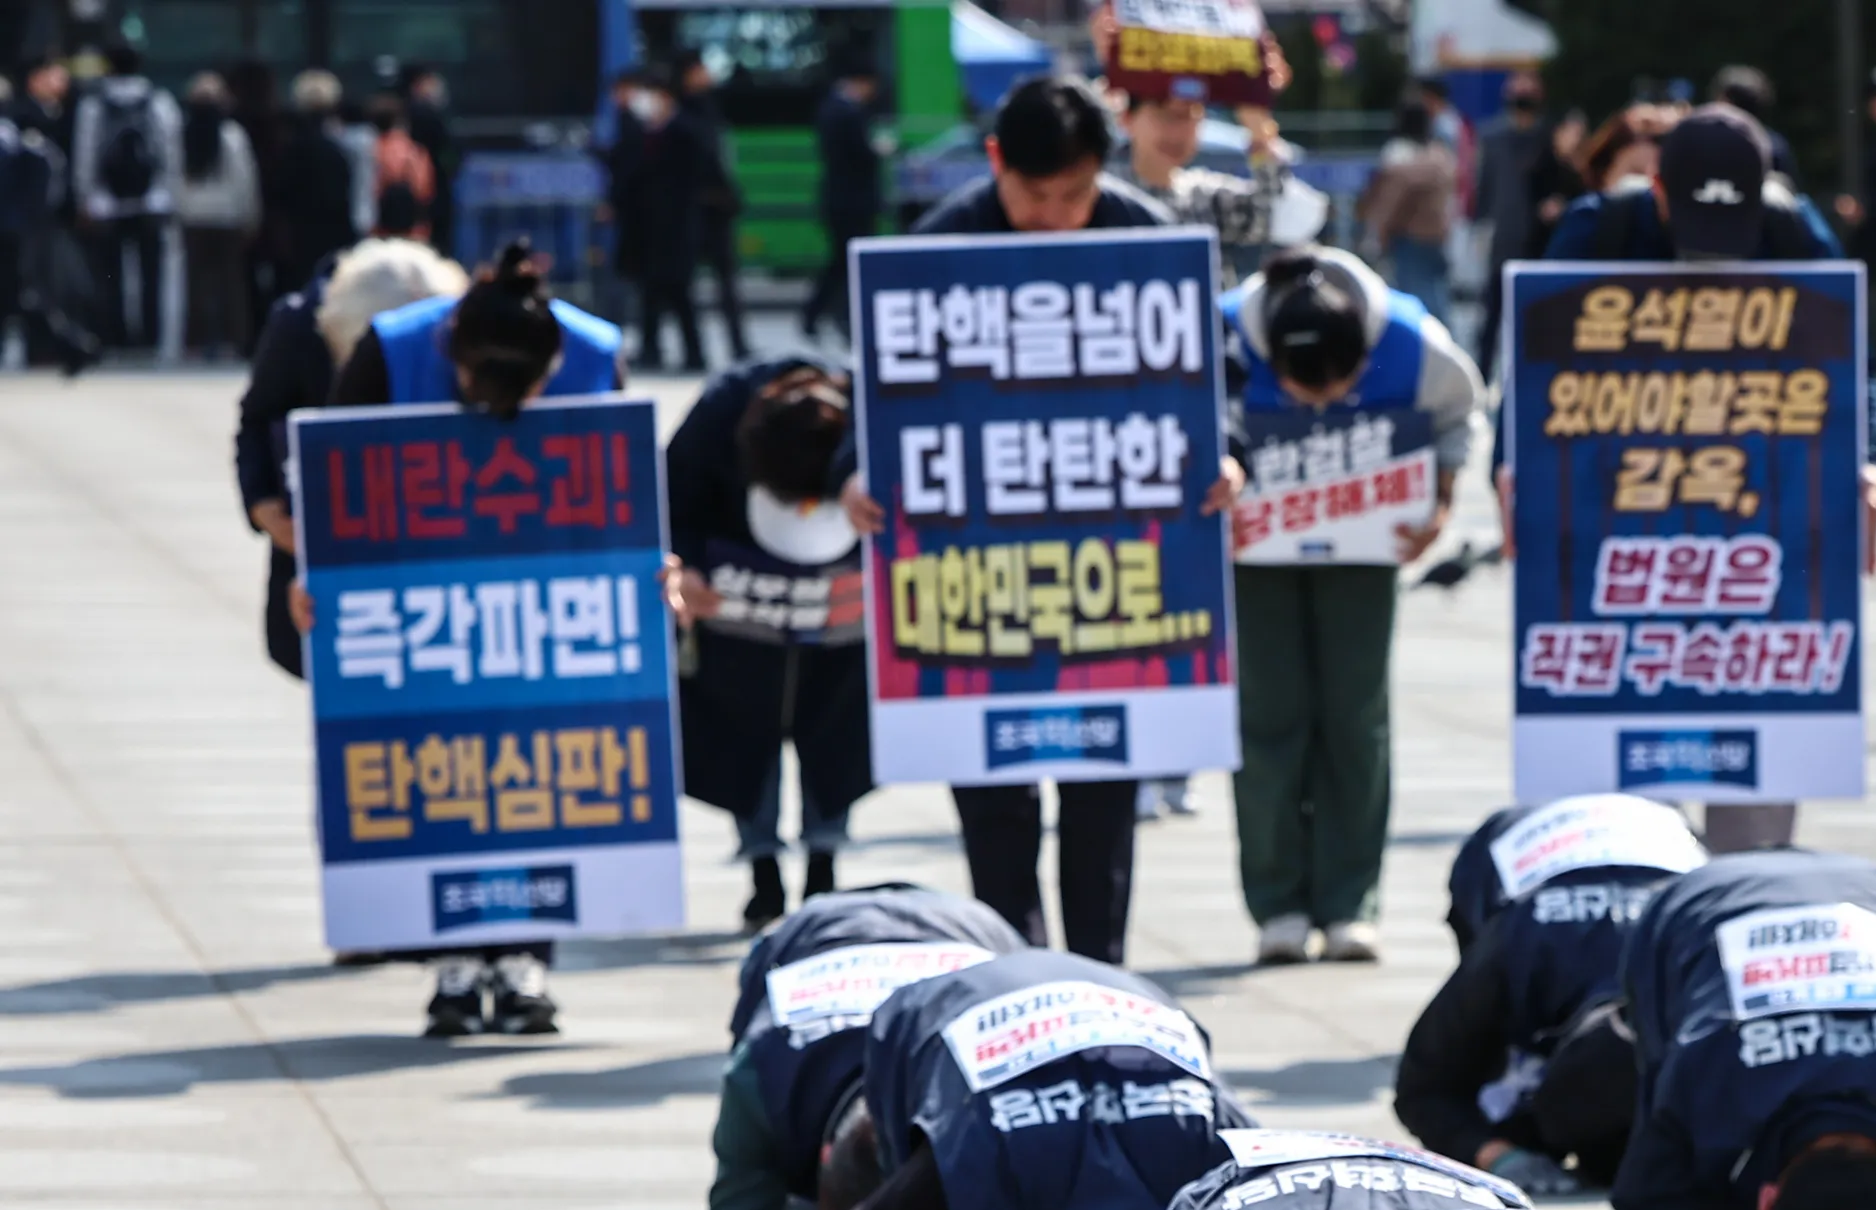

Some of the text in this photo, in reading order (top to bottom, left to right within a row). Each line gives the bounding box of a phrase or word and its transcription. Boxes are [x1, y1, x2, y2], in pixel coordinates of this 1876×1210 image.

[873, 278, 1203, 384] 탄핵을넘어
[1572, 285, 1797, 351] 윤석열이
[1544, 368, 1829, 436] 있어야할곳은
[328, 432, 634, 542] 내란수괴!
[901, 411, 1188, 517] 더 탄탄한
[1613, 444, 1759, 518] 감옥,
[892, 537, 1212, 657] 대한민국으로...
[1594, 535, 1781, 613] 법원은
[334, 573, 643, 689] 즉각파면!
[1522, 620, 1853, 694] 직권 구속하라!
[342, 725, 652, 842] 탄핵심판!
